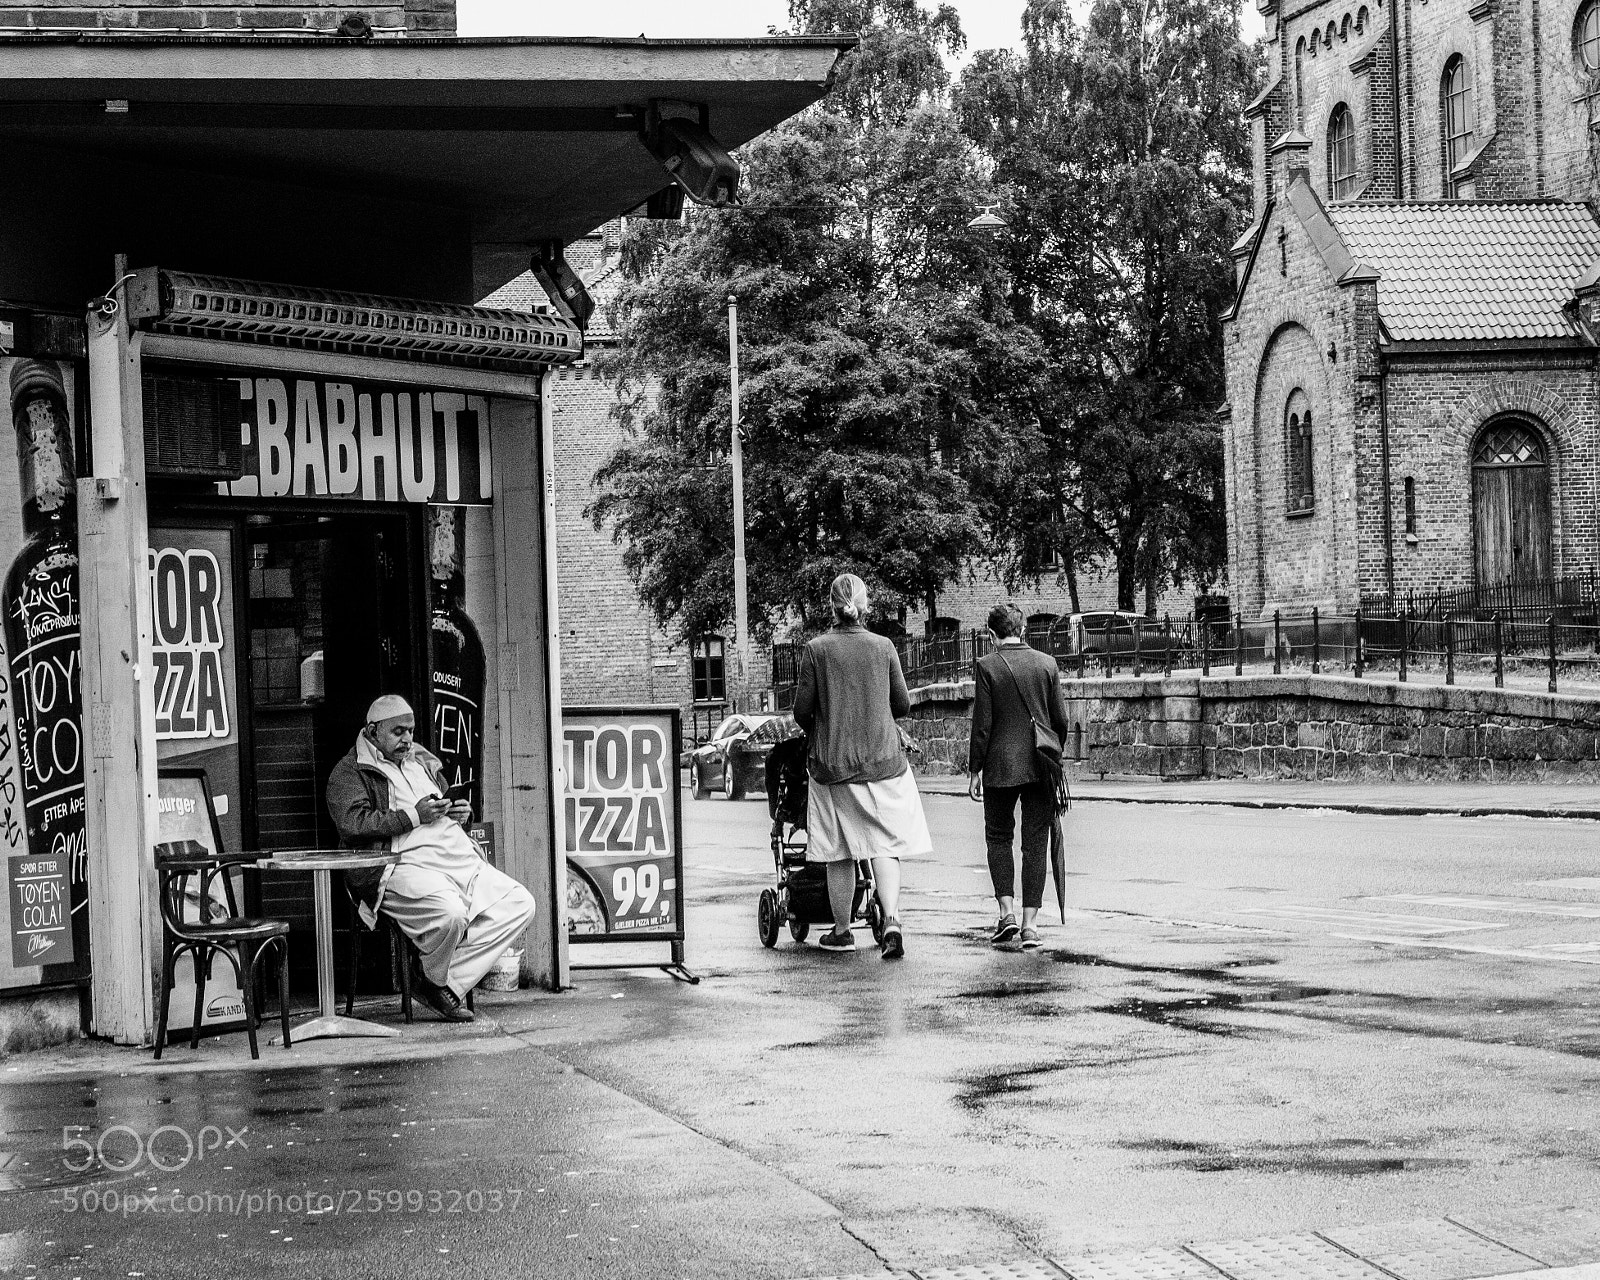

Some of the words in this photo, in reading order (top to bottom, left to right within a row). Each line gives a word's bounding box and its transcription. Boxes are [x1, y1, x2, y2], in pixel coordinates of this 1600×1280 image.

[213, 378, 492, 502] EBABHUTT
[149, 548, 223, 649] OR
[16, 650, 81, 720] TØY
[562, 725, 667, 794] TOR
[44, 803, 68, 823] ETTER
[38, 860, 57, 873] ETTER
[23, 903, 62, 927] COLA!
